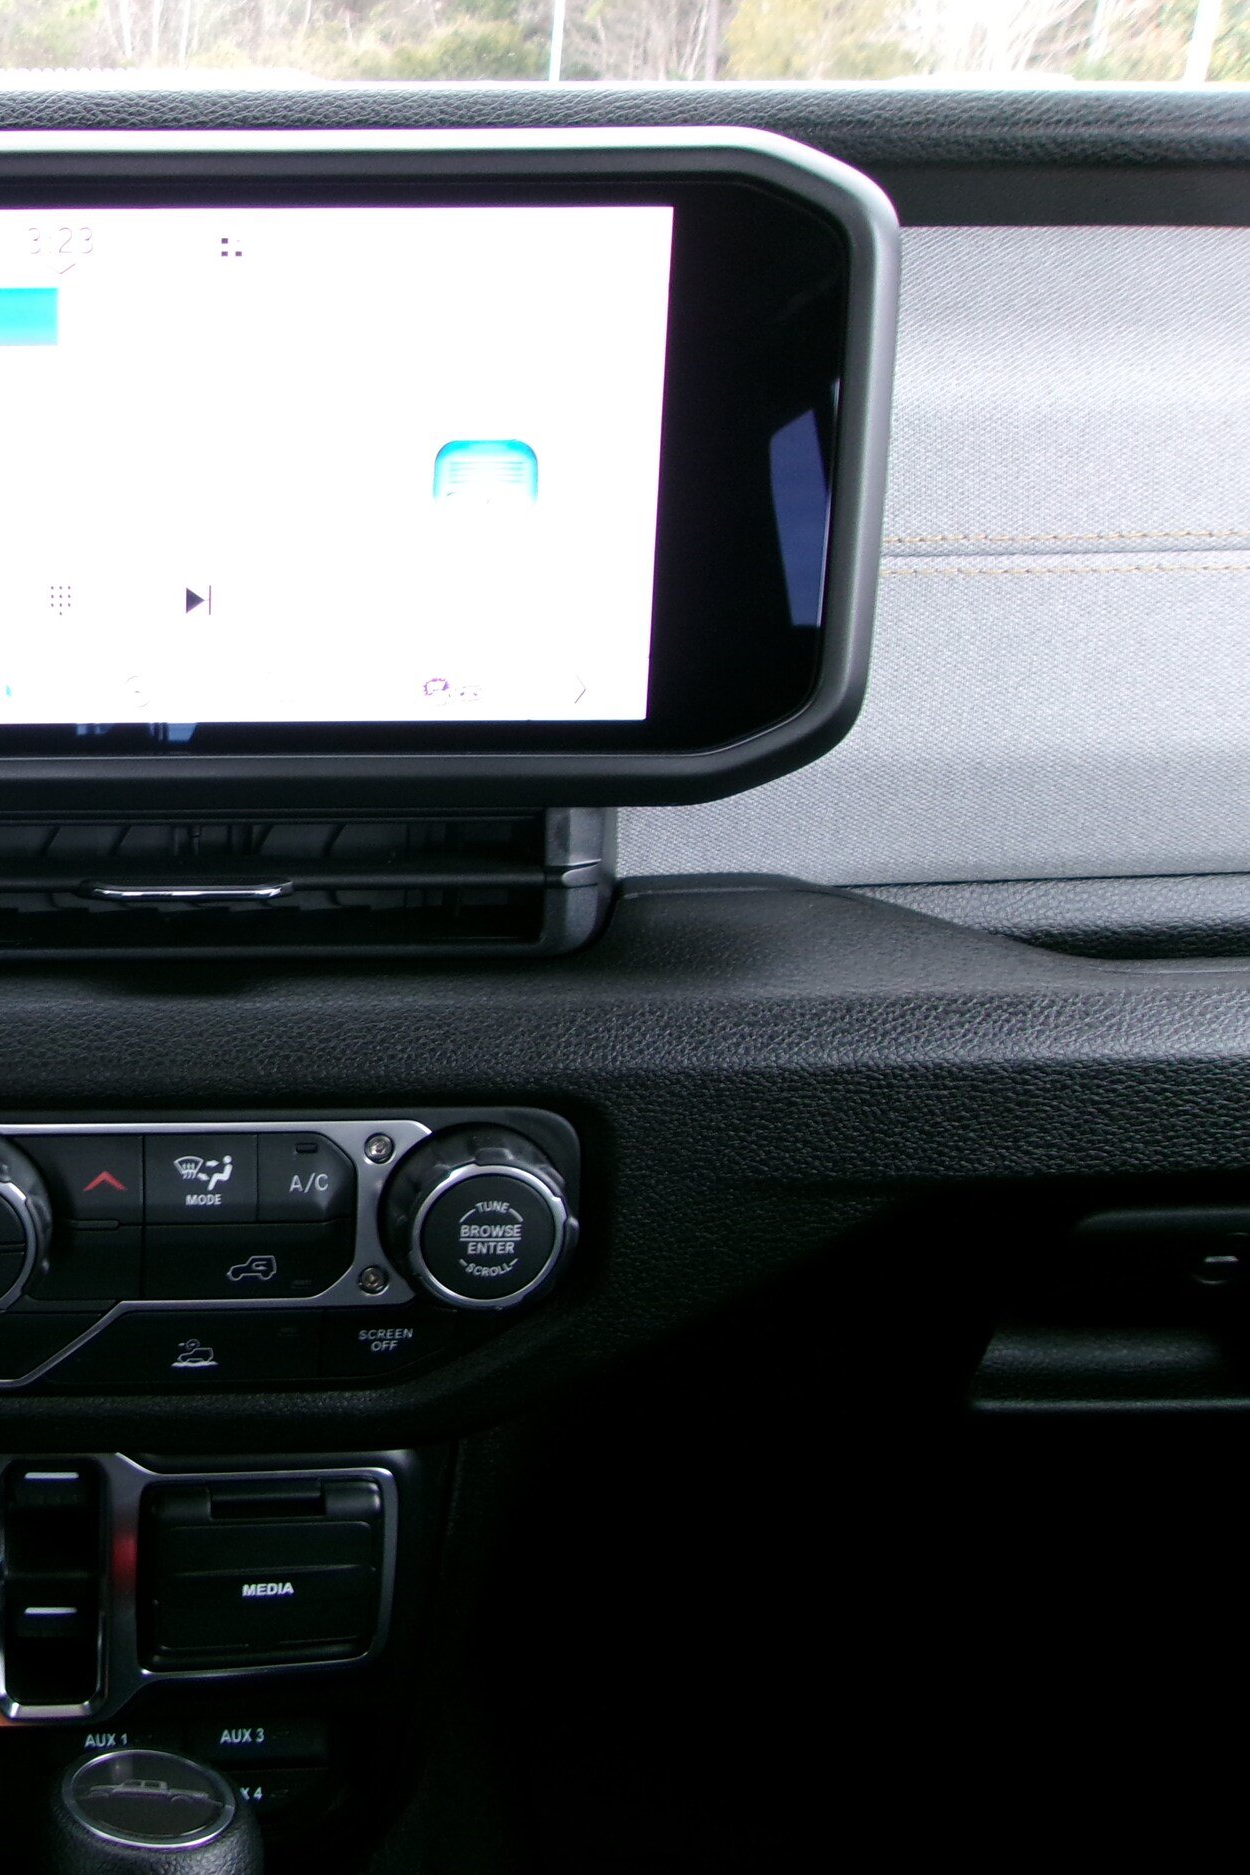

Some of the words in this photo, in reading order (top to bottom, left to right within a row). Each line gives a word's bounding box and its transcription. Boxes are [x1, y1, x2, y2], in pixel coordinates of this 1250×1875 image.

[289, 1172, 329, 1194] A/C
[185, 1193, 222, 1207] MODE
[475, 1200, 511, 1214] TUNE
[459, 1224, 523, 1238] BROWSE
[467, 1241, 515, 1255] ENTER
[465, 1262, 513, 1278] SCROLL
[358, 1328, 414, 1341] SCREEN
[370, 1340, 399, 1352] OFF
[242, 1582, 294, 1597] MEDIA
[84, 1733, 117, 1748] AUX
[120, 1733, 128, 1747] 1
[220, 1728, 252, 1745] AUX
[254, 1728, 266, 1744] 3
[253, 1786, 263, 1800] 4
